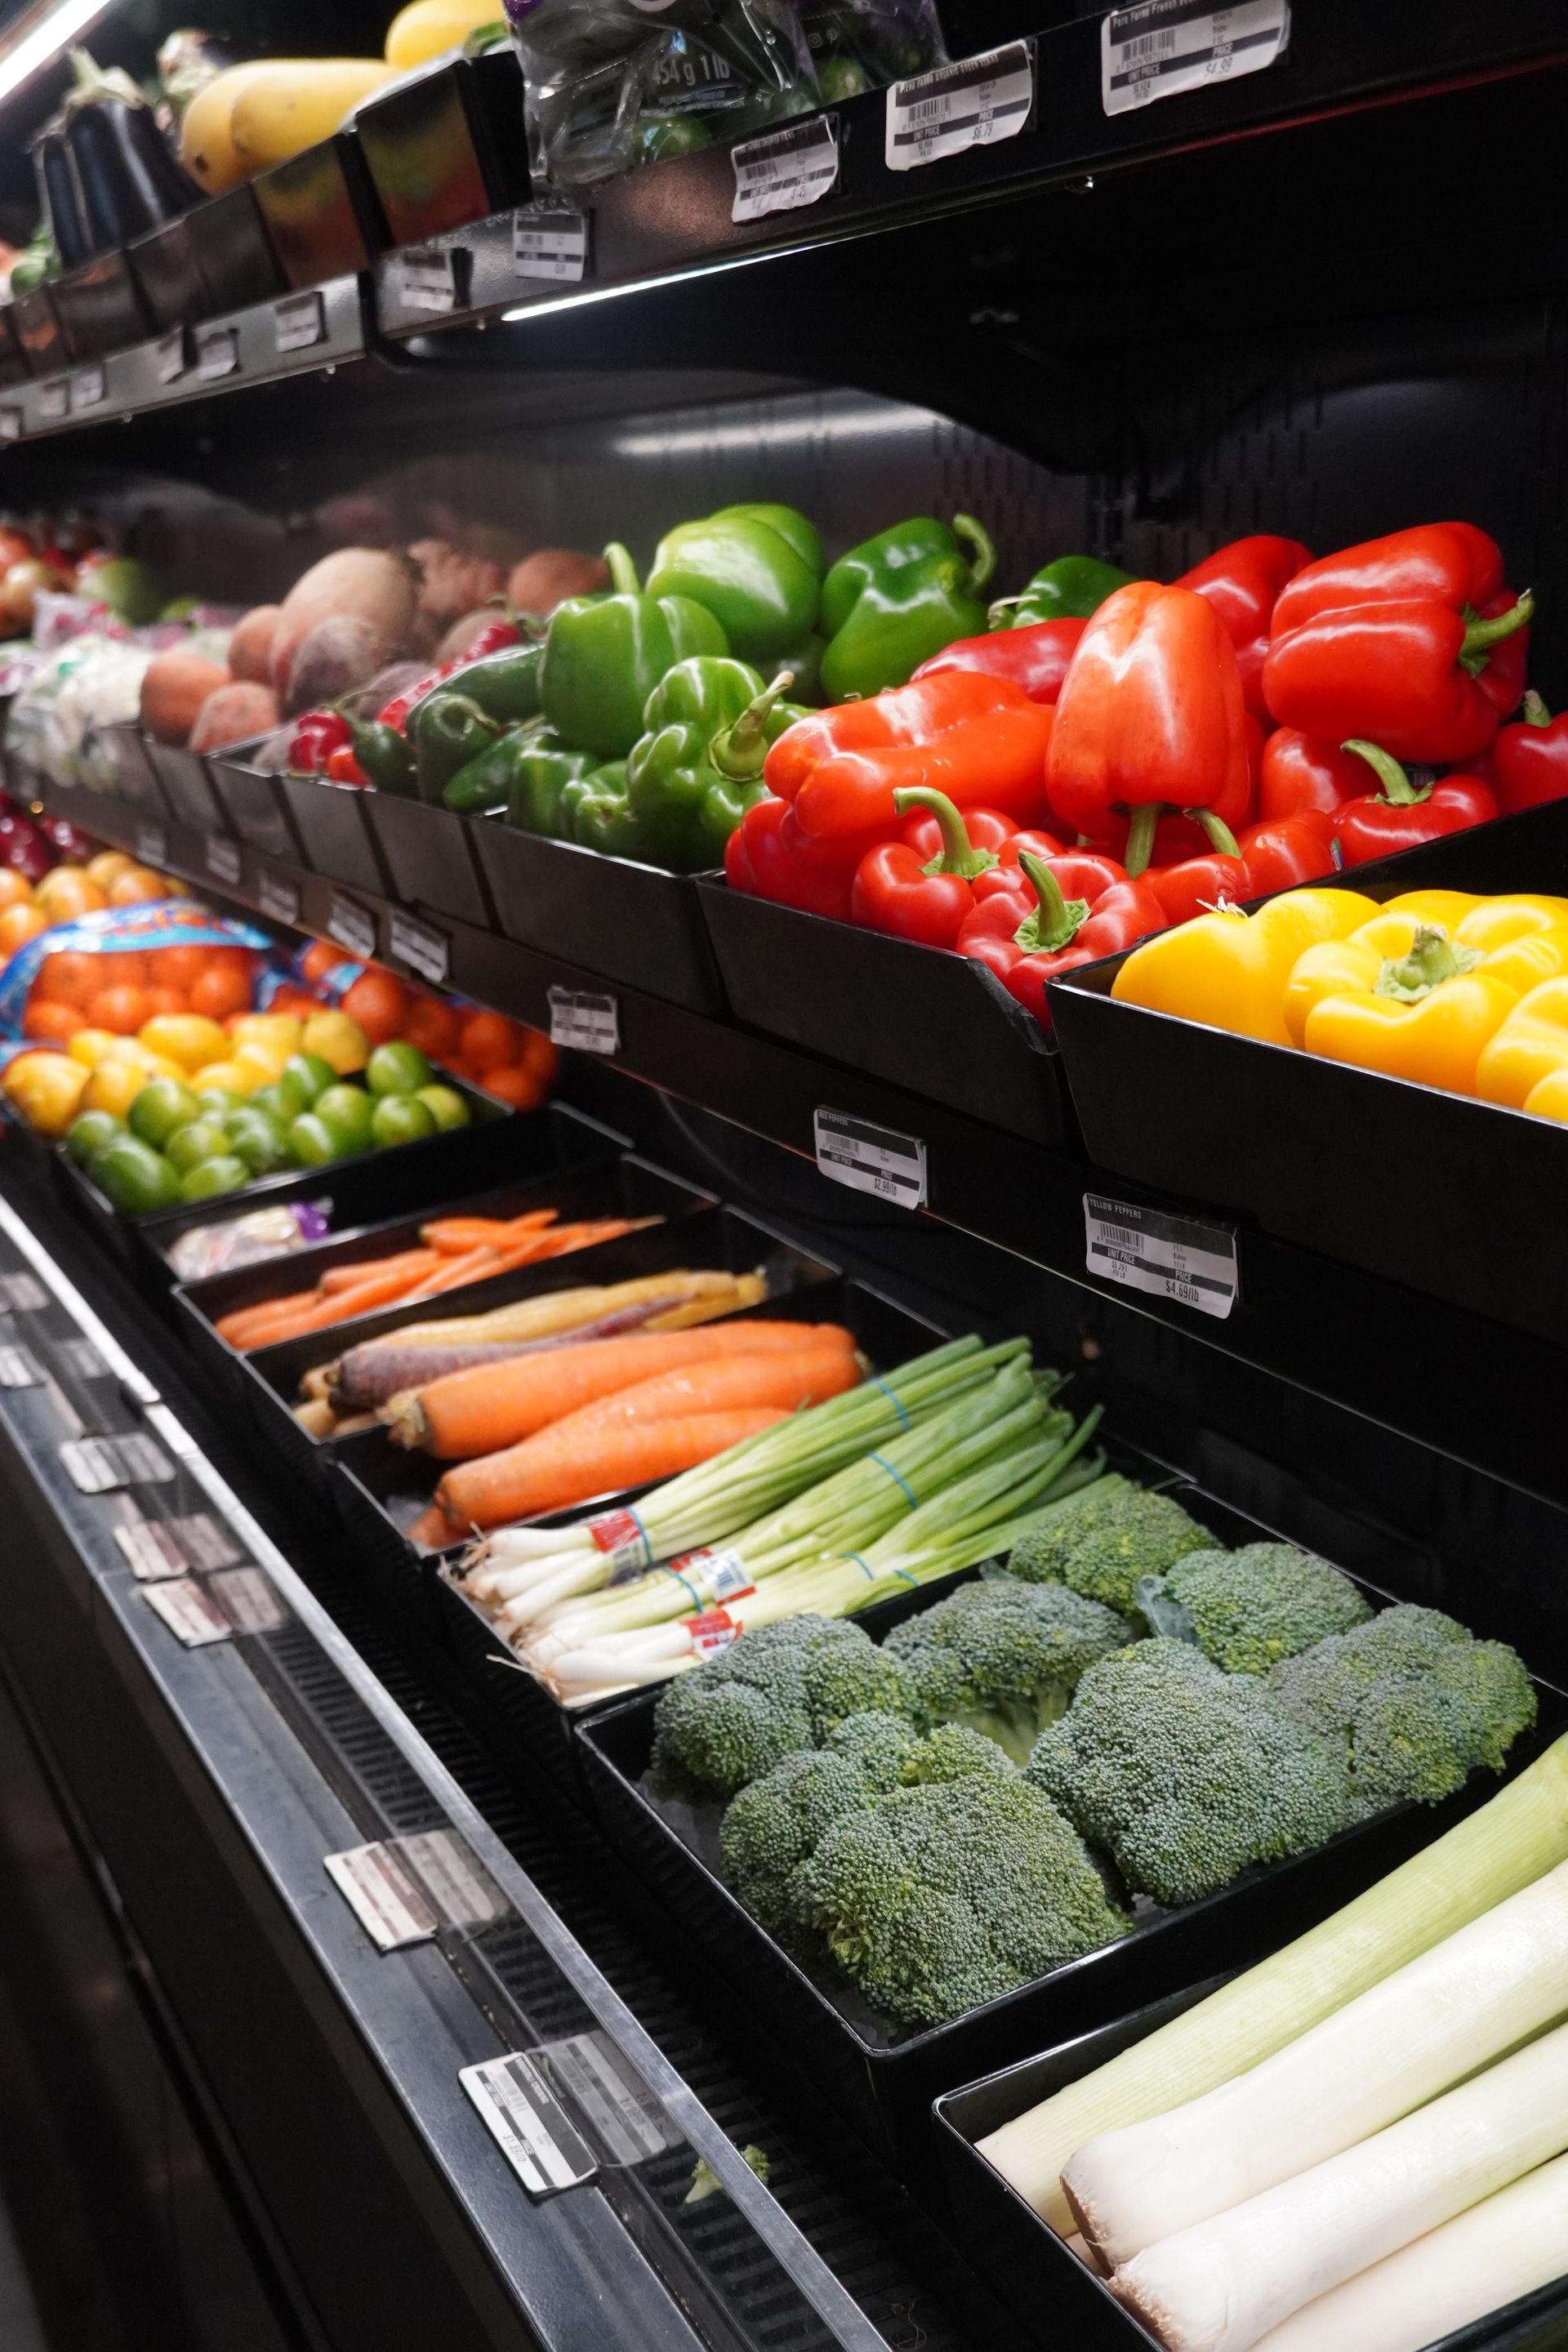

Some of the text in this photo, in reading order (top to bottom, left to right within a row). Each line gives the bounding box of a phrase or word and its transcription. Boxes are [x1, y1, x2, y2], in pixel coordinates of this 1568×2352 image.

[1213, 42, 1233, 59] PRICE
[652, 51, 730, 87] 454 g 1 lb
[1142, 62, 1160, 79] PRICE
[1205, 56, 1234, 79] $4.99
[978, 109, 994, 124] PRICE
[924, 124, 941, 139] PRICE
[972, 121, 994, 140] $6.79
[841, 1156, 853, 1167] PRICE
[880, 1169, 893, 1181] PRICE
[874, 1177, 898, 1196] $2.99/lb
[1089, 1197, 1143, 1220] YELLOW PEPPERS
[1107, 1247, 1136, 1266] UNIT PRICE
[1175, 1269, 1193, 1284] PRICE
[1165, 1280, 1200, 1303] $4.69/lb
